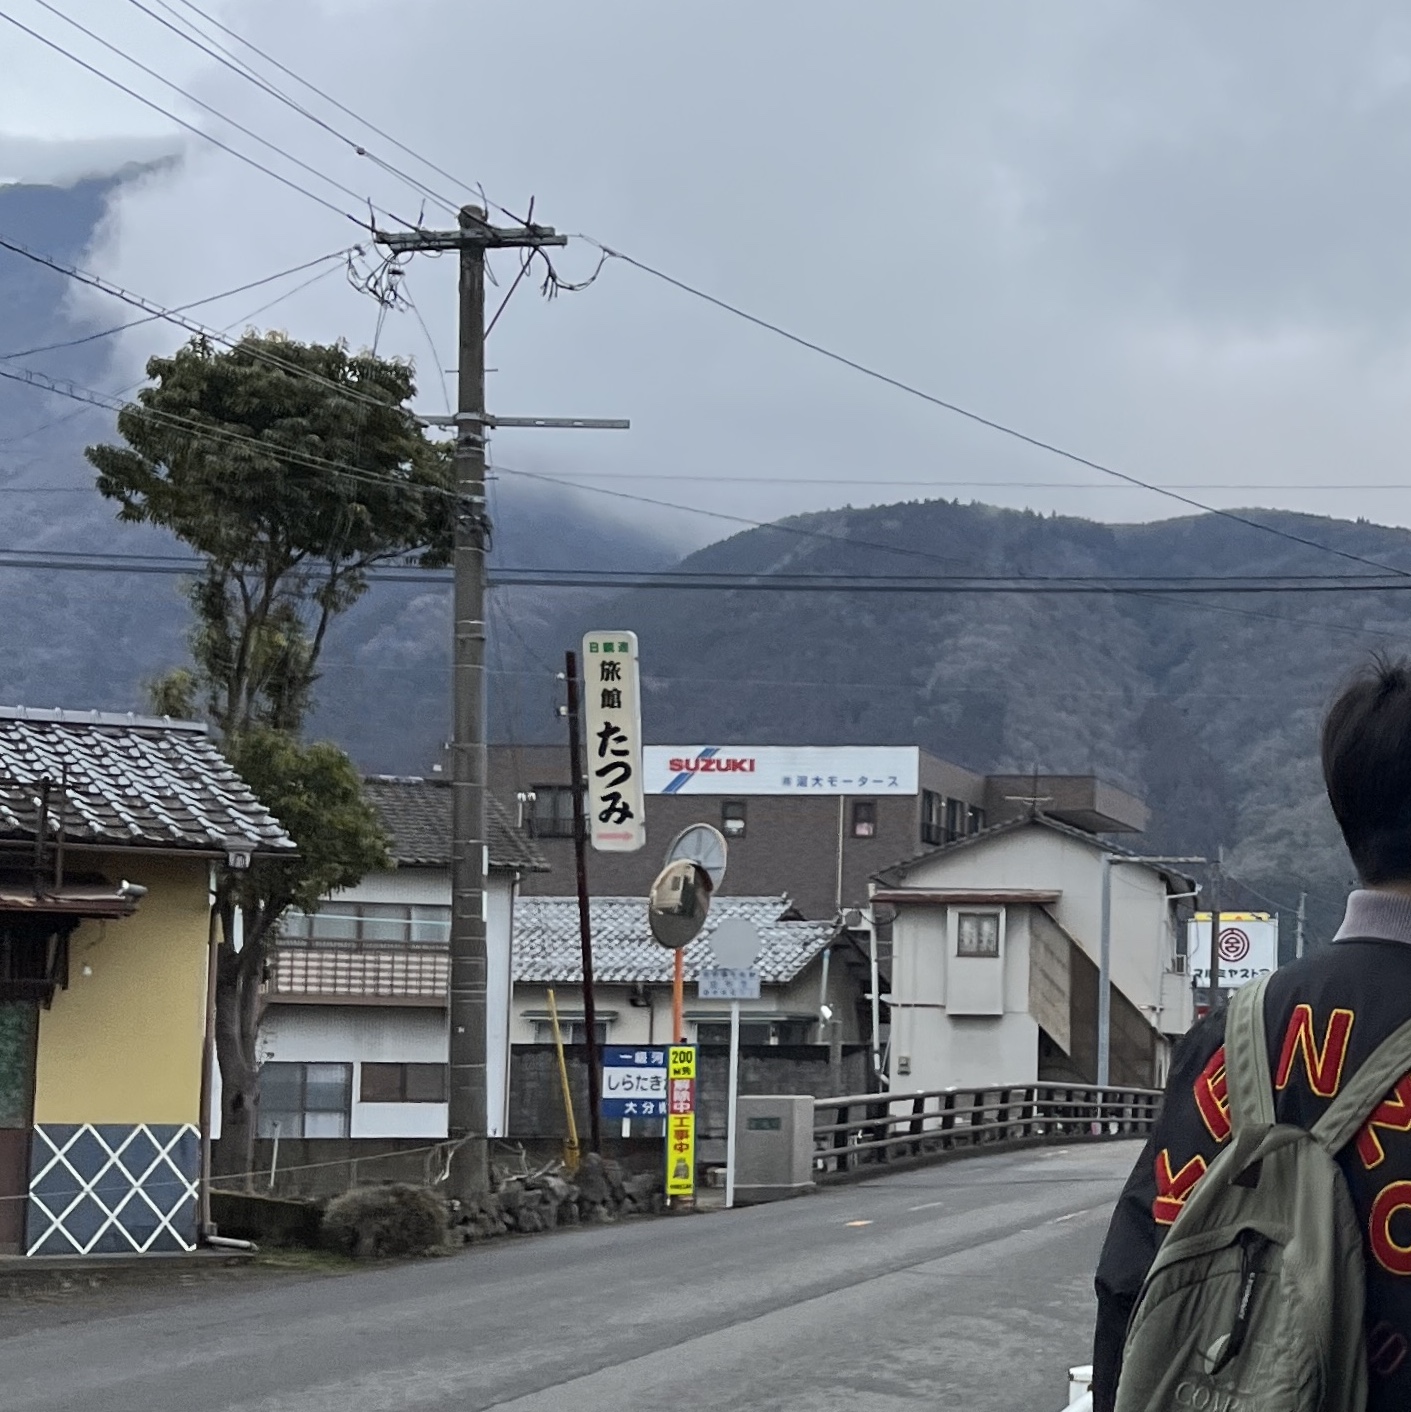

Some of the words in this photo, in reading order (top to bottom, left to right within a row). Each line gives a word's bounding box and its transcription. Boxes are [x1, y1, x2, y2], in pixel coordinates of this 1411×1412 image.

[600, 660, 622, 709] 旅館
[595, 721, 634, 825] たつみ
[669, 758, 756, 773] SUZUKI
[619, 1051, 665, 1065] 一級河
[672, 1051, 692, 1064] 200
[608, 1073, 667, 1092] しらたき
